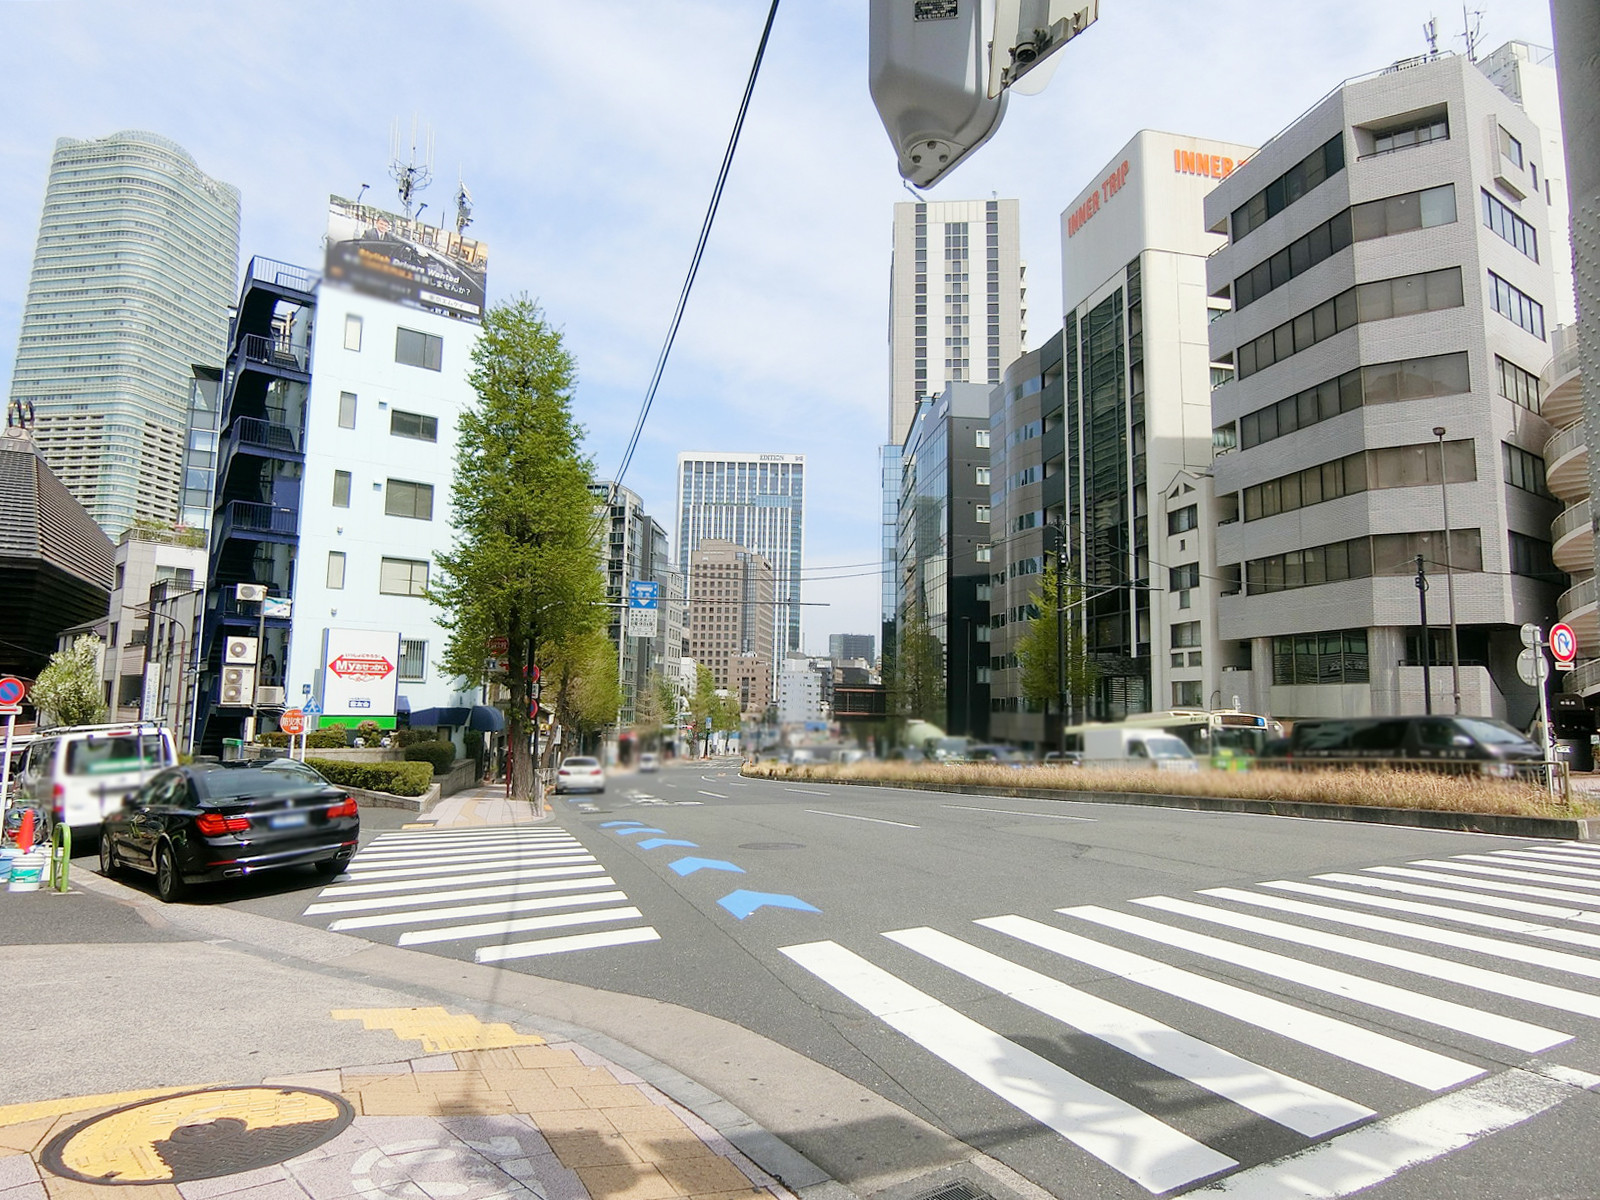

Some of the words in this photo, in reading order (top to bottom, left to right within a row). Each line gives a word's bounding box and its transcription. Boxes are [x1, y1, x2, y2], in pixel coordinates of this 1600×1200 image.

[1174, 149, 1234, 179] INNER
[1067, 190, 1100, 238] INNER
[1102, 160, 1129, 203] TRIP
[391, 258, 426, 274] Drivers
[427, 267, 460, 284] Wanted
